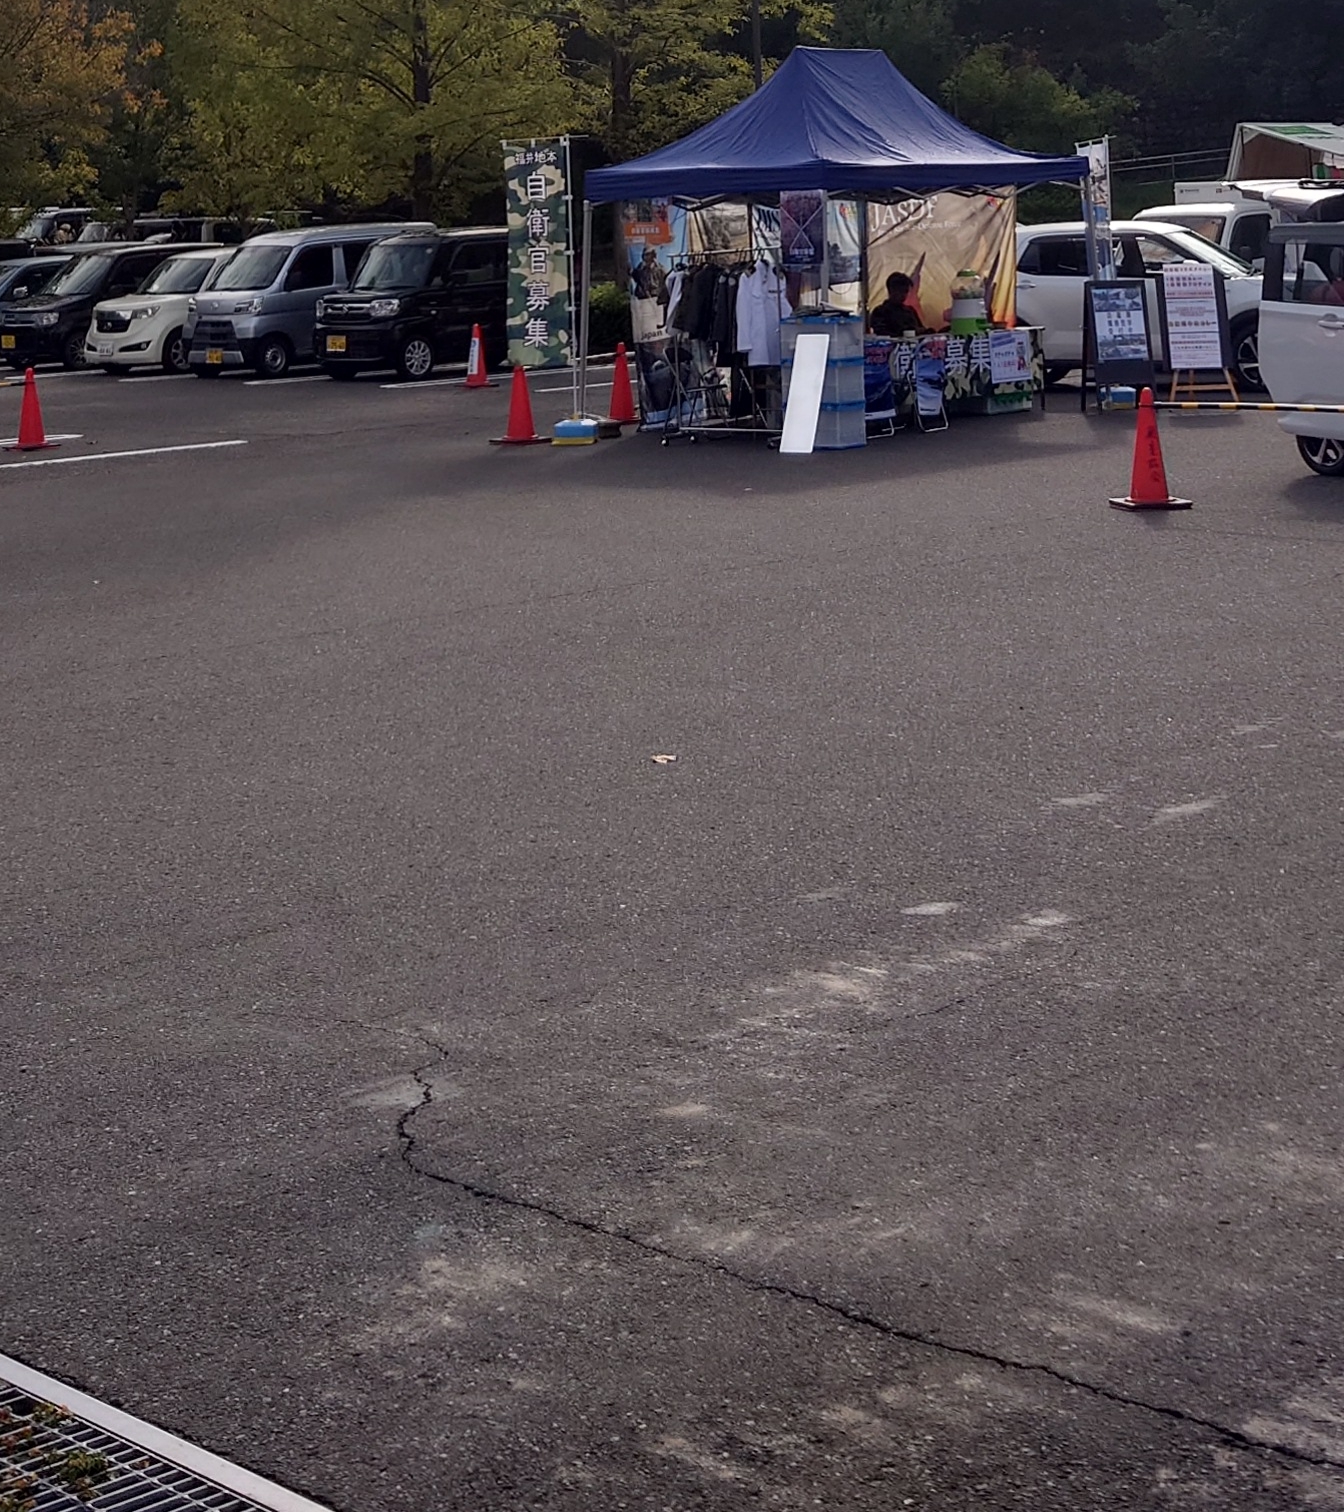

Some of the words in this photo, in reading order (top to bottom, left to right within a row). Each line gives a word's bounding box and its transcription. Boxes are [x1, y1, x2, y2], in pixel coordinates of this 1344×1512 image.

[515, 150, 557, 165] 福井地本
[524, 172, 550, 348] 自衛官募集
